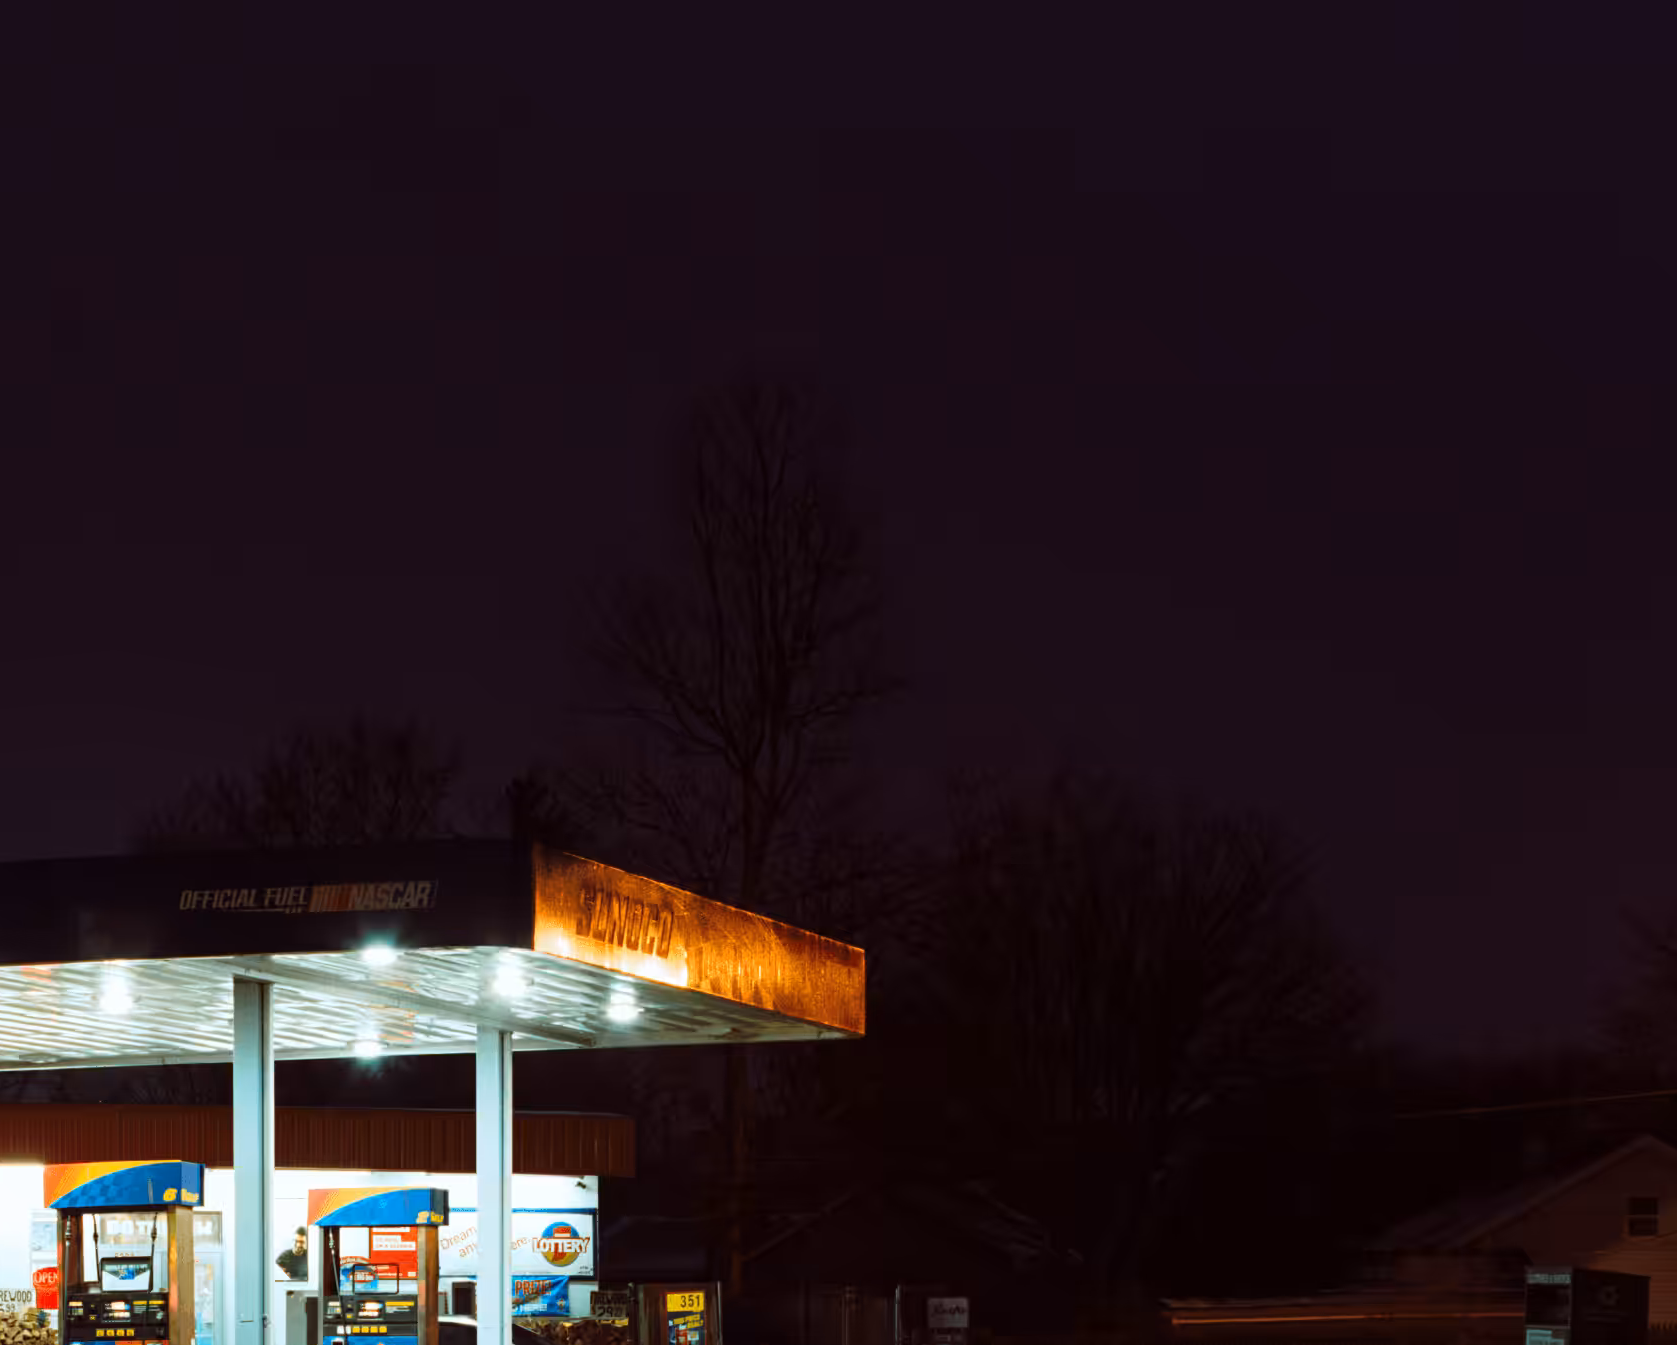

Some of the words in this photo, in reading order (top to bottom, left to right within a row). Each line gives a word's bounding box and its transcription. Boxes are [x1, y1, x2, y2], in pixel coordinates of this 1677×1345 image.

[179, 888, 257, 911] OFFICIAL
[265, 886, 308, 907] FUEL
[347, 880, 433, 911] NASCAR
[532, 1236, 591, 1254] LOTTERY
[680, 1294, 701, 1308] 351
